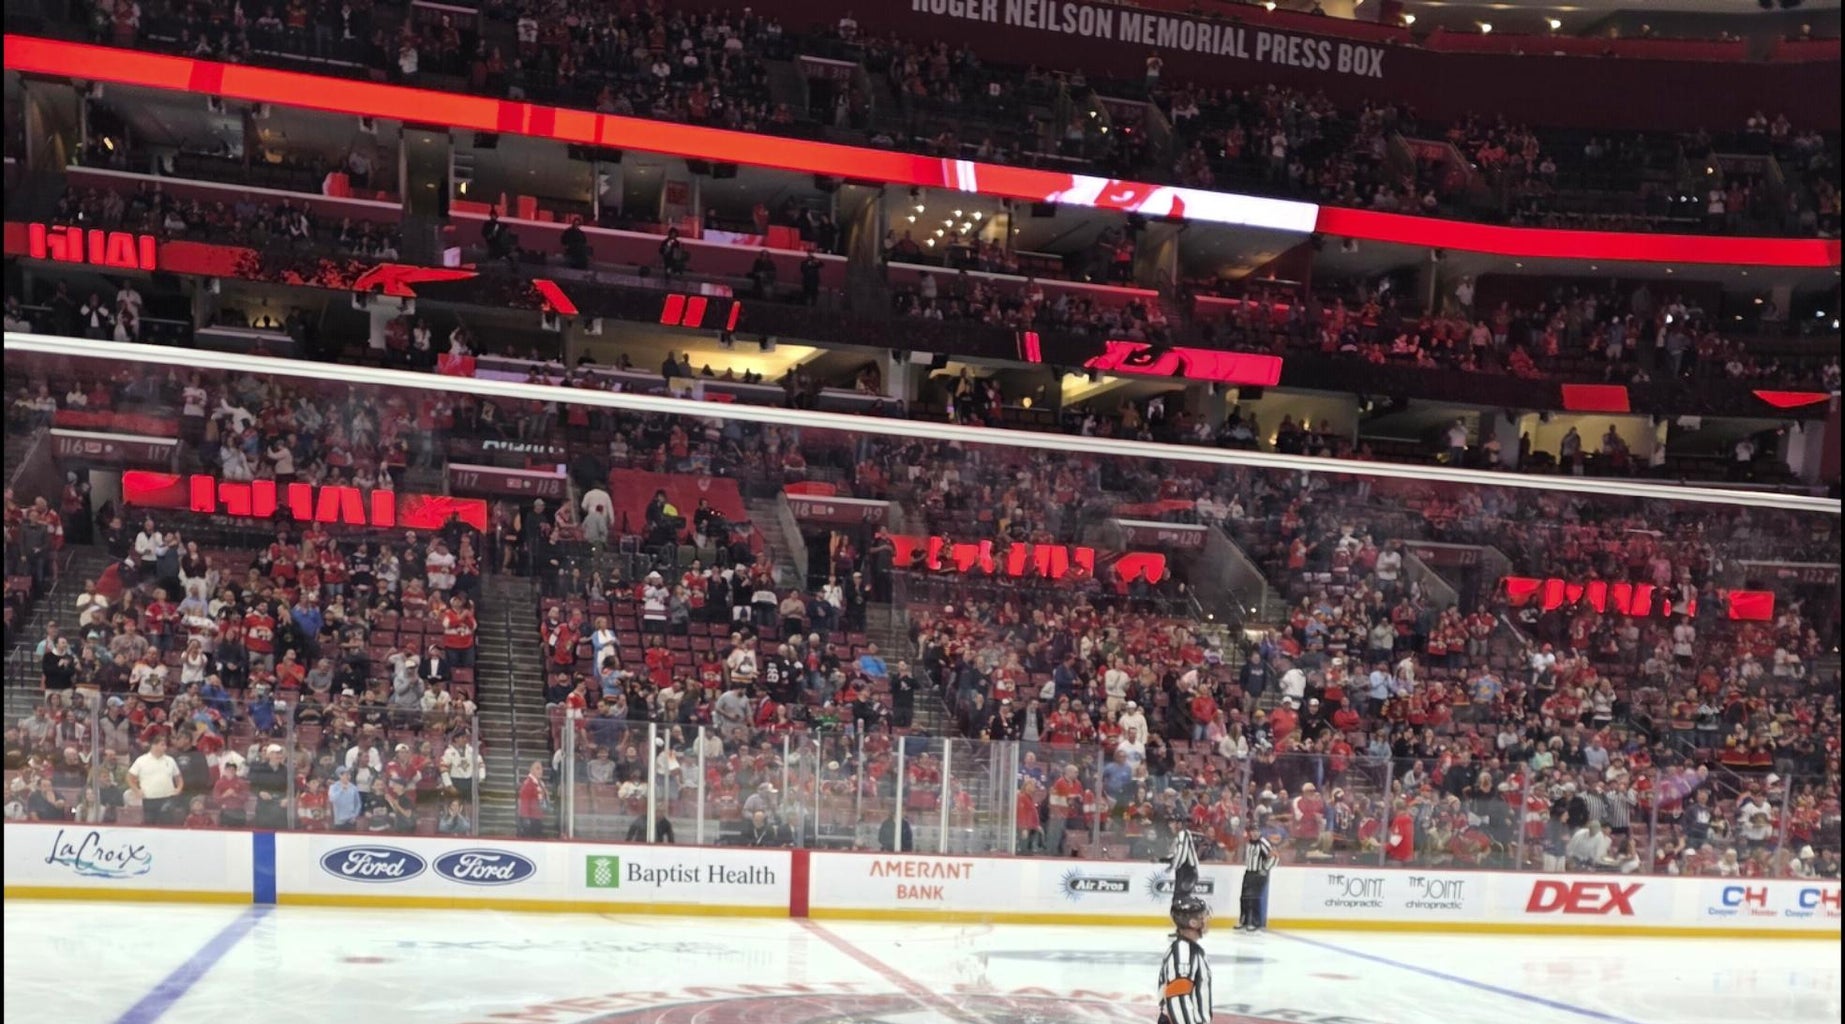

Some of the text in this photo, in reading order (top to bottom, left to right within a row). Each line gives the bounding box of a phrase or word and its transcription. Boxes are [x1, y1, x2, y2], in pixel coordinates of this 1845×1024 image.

[1004, 0, 1112, 39] NEILSON
[1119, 11, 1249, 59] MEMORIAL
[1256, 31, 1332, 71] PRESS
[1337, 43, 1385, 78] BOX
[60, 438, 171, 460] 116 117
[456, 471, 561, 495] 117 118
[1179, 530, 1202, 545] 120
[45, 829, 146, 870] LaCroix
[341, 849, 406, 877] Ford
[452, 852, 516, 880] Ford
[869, 860, 974, 879] AMERANT
[627, 862, 776, 888] Baptist Health
[1076, 879, 1124, 892] Air Pros
[896, 883, 945, 901] BANK
[1161, 881, 1175, 892] Ai
[1342, 877, 1385, 898] JOINT
[1422, 879, 1465, 900] JOINT
[1722, 886, 1769, 907] CH
[1324, 898, 1384, 909] chiropractic
[1405, 900, 1463, 910] chiropractic
[1525, 880, 1646, 916] DEX
[1799, 888, 1841, 910] CH
